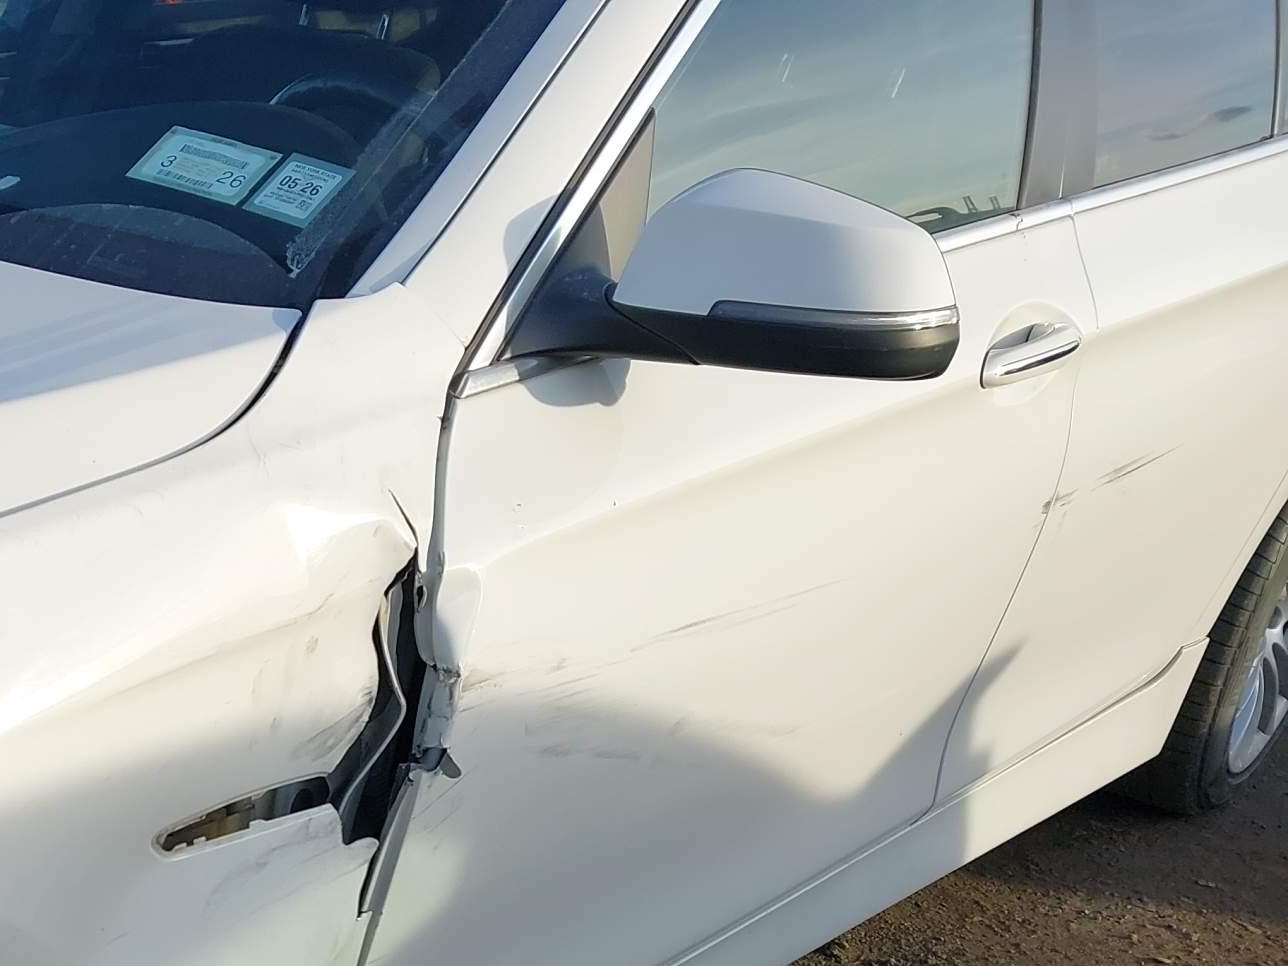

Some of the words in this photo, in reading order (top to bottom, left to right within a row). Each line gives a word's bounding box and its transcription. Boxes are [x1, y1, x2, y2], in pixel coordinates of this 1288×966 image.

[160, 155, 177, 168] 3
[216, 170, 247, 188] 26
[279, 175, 302, 189] 05
[300, 181, 323, 196] 26
